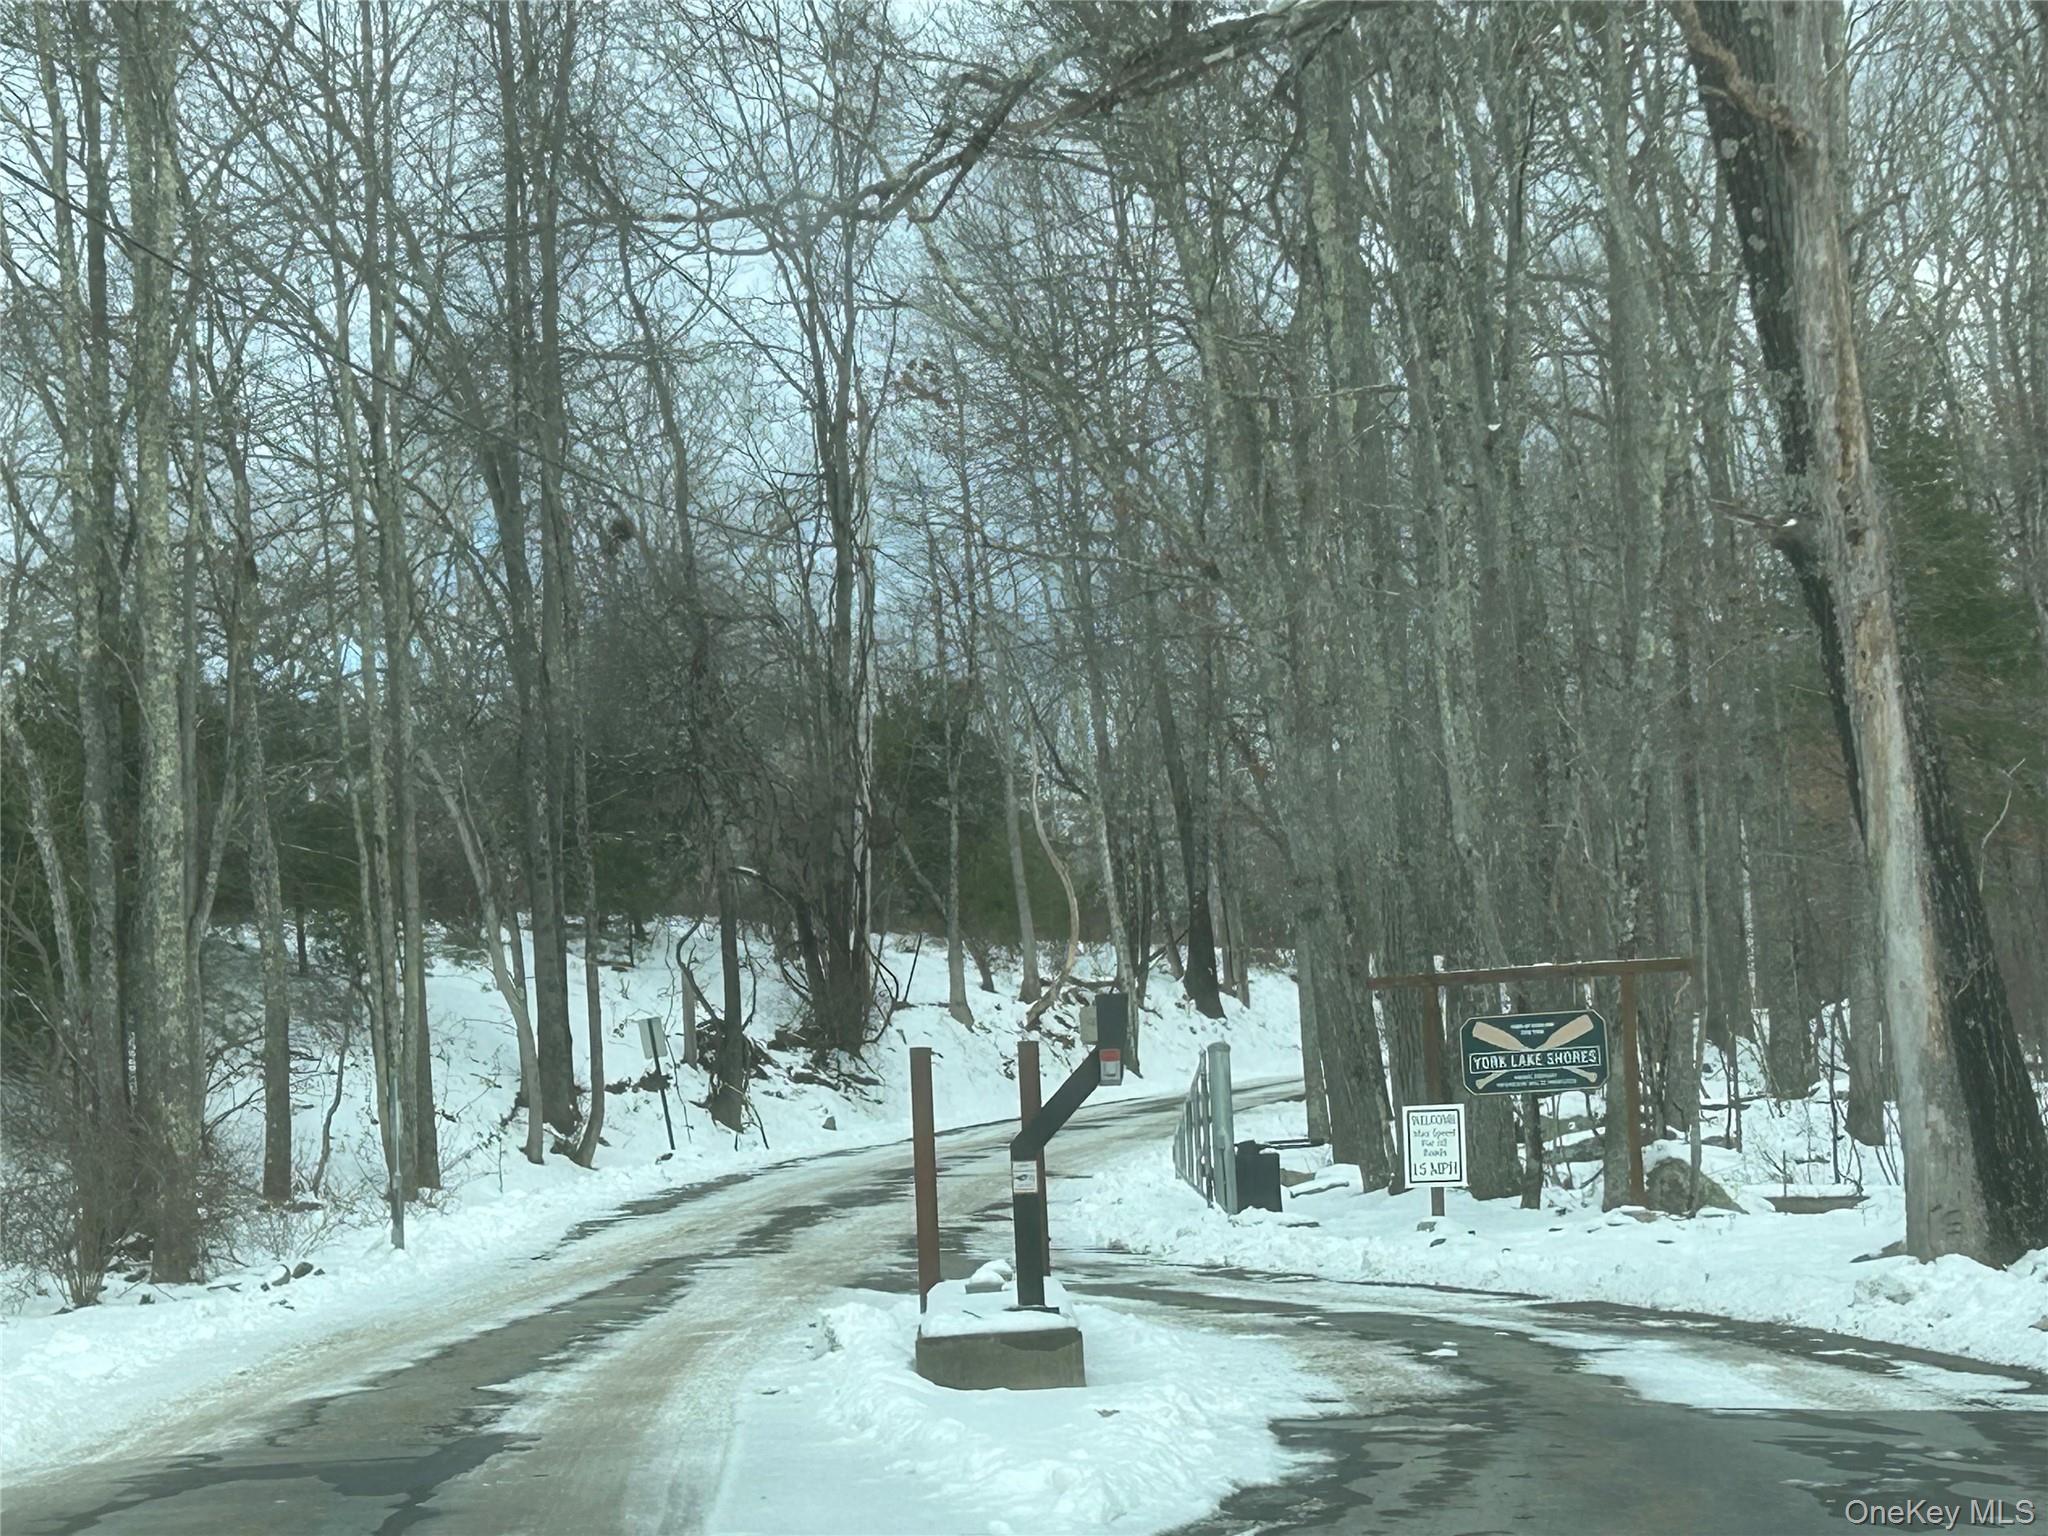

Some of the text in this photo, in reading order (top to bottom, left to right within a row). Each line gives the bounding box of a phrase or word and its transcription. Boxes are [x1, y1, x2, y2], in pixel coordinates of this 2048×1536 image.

[1474, 1048, 1597, 1070] YORK LAKE SHORES
[1411, 1113, 1456, 1126] WELCOME
[1432, 1128, 1456, 1139] Speed
[1413, 1161, 1458, 1176] 15 MPH
